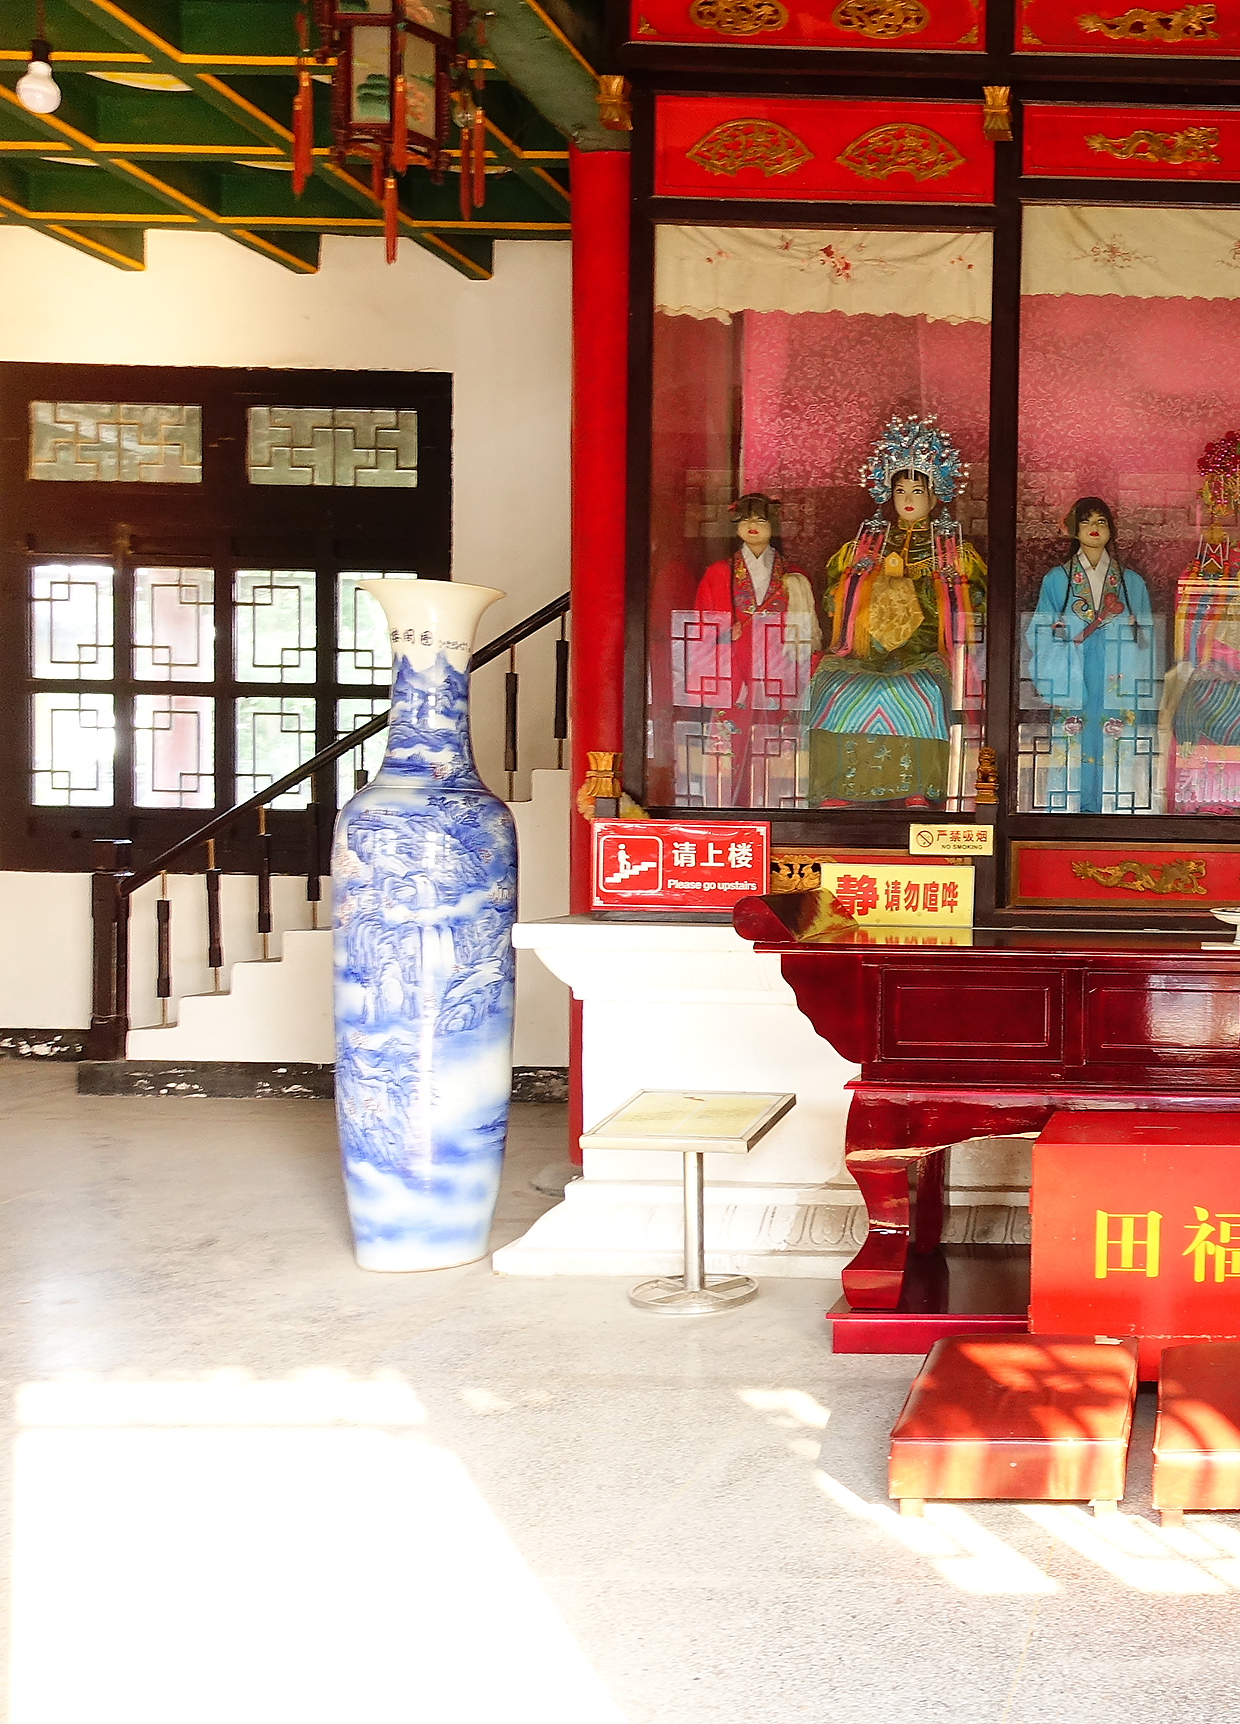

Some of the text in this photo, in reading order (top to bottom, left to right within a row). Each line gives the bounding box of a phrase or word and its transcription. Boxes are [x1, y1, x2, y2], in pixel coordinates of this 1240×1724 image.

[936, 829, 988, 843] 严禁吸烟
[672, 842, 754, 869] 请上楼
[667, 879, 757, 892] Please go upstairs
[836, 874, 959, 916] 静 请勿喧哗
